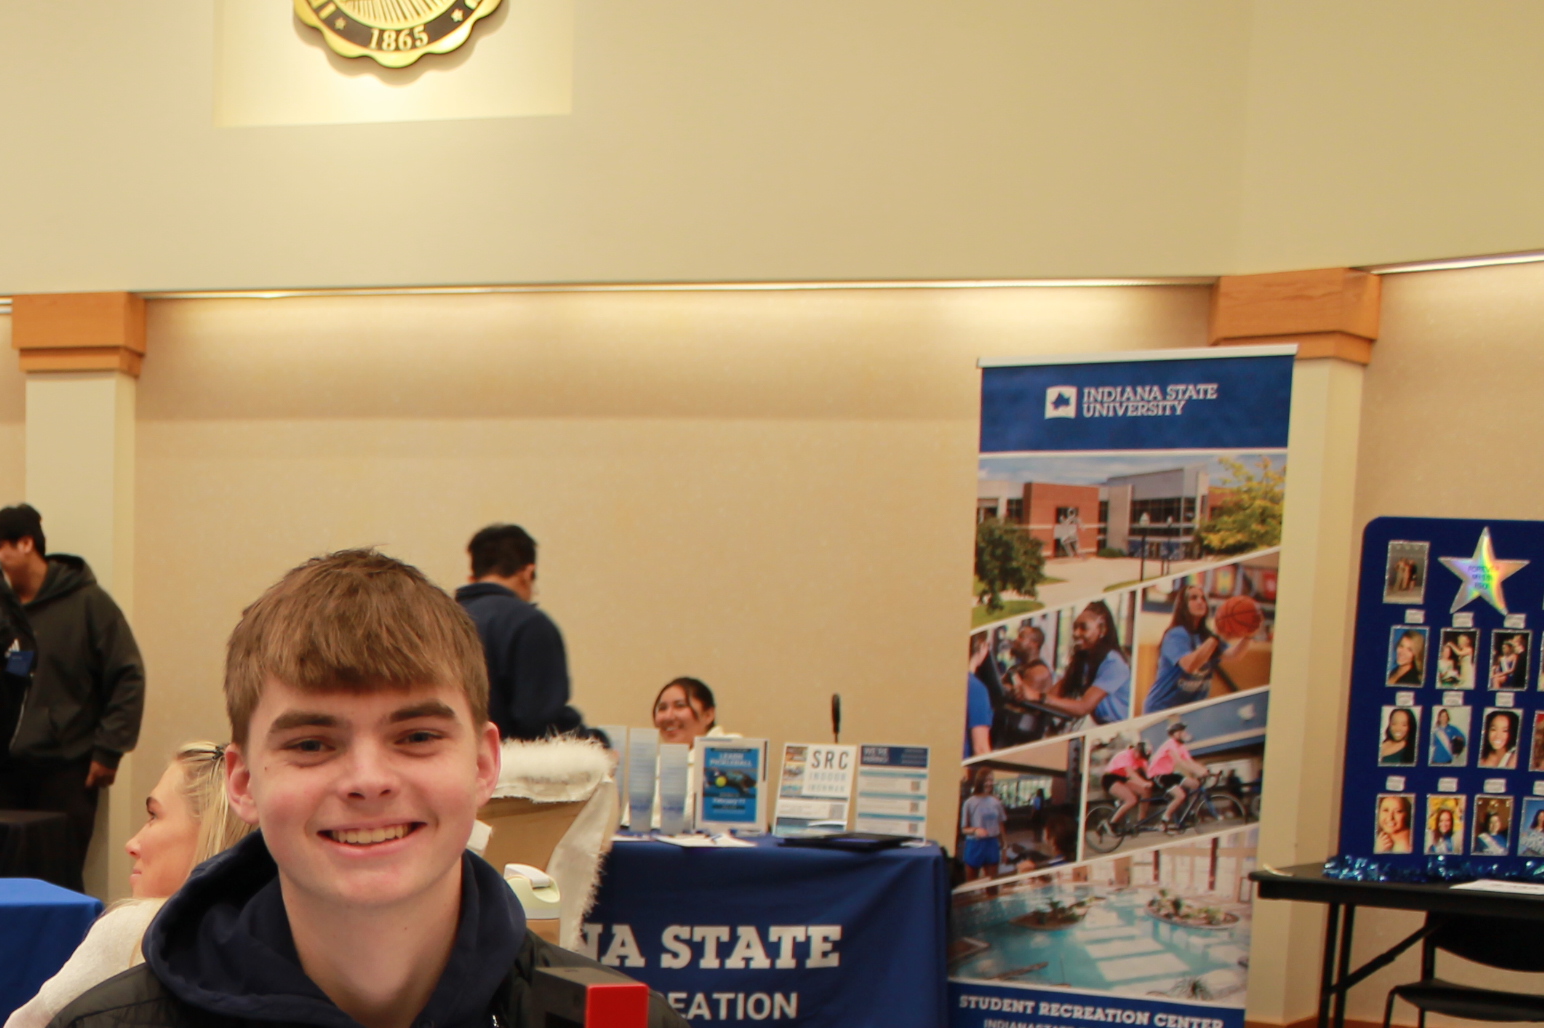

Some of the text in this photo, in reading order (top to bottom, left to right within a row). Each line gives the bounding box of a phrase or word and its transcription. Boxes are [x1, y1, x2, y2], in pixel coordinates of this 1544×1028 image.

[369, 24, 428, 51] 1865
[1083, 383, 1218, 402] INDIANA STATE
[1082, 400, 1187, 418] UNIVERSITY
[811, 750, 849, 770] SRC
[659, 924, 842, 969] STATE
[658, 992, 799, 1020] EATION
[959, 995, 1036, 1015] STUDENT
[1038, 1001, 1150, 1026] RECREATION
